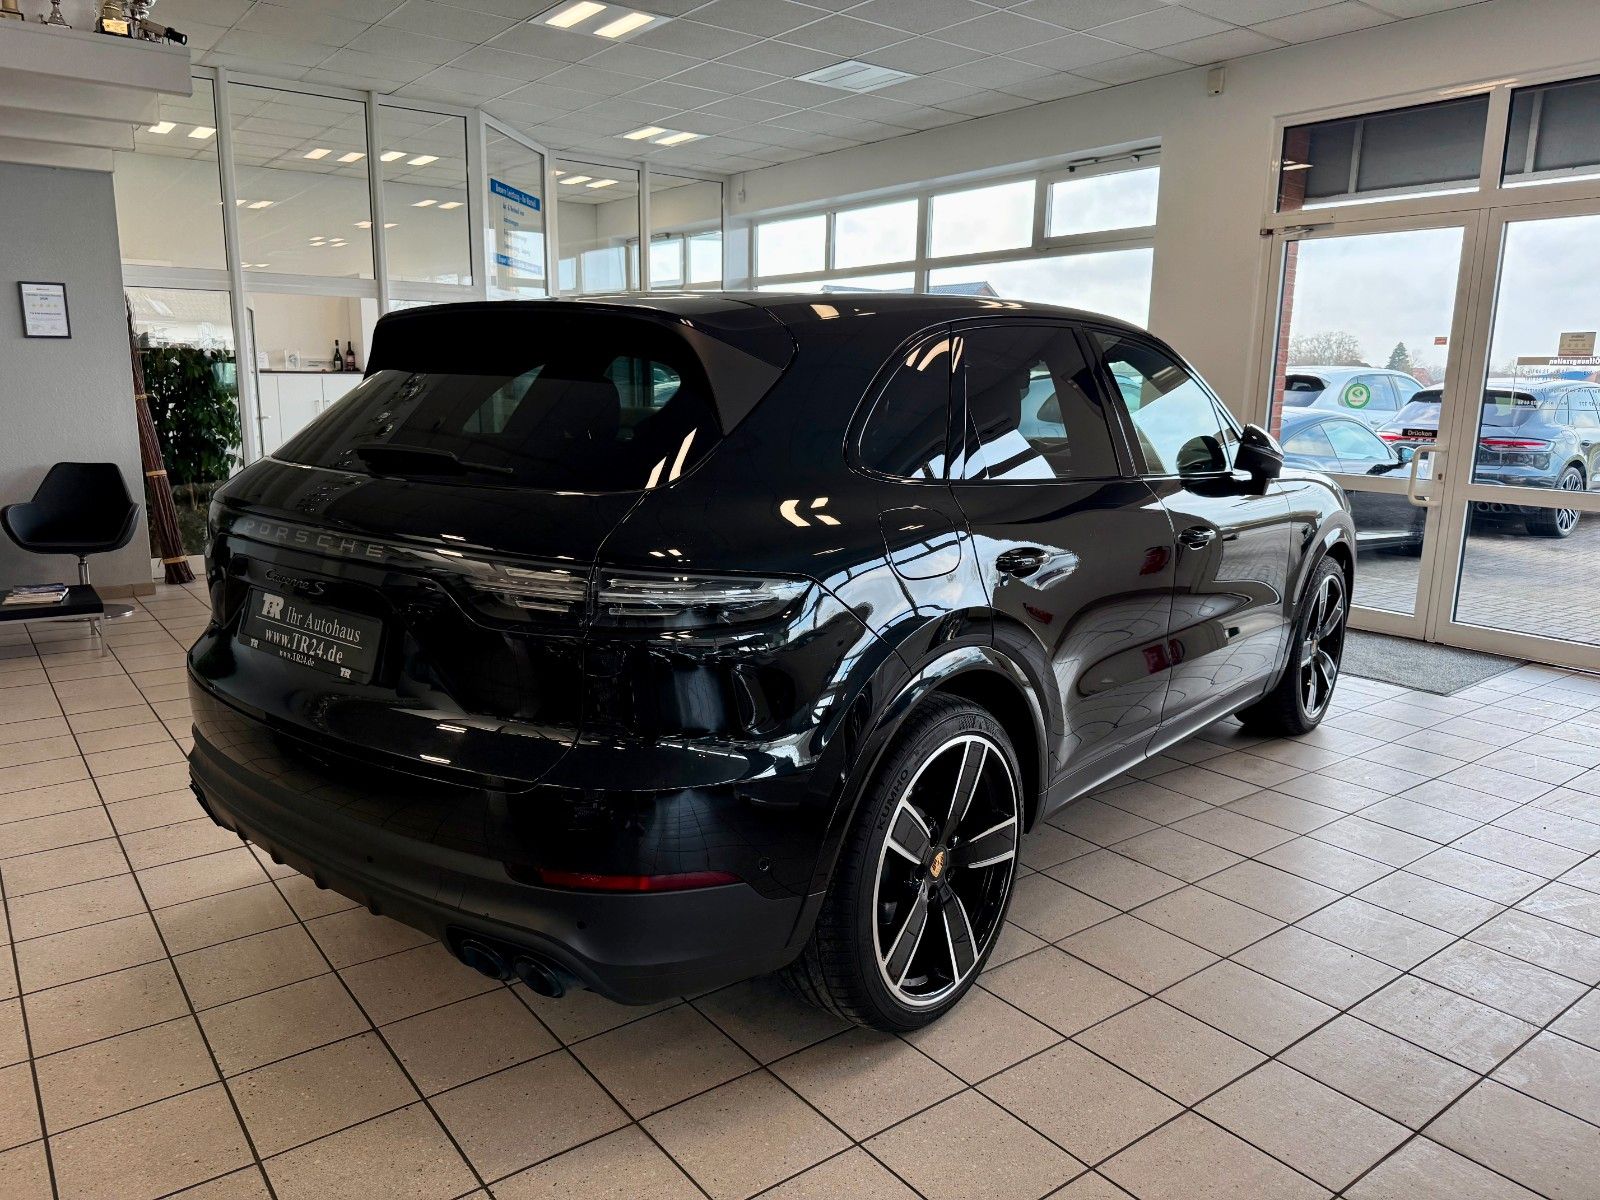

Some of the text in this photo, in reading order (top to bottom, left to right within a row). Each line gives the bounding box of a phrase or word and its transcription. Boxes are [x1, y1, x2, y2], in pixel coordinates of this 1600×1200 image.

[1407, 429, 1432, 437] Drücken
[245, 520, 384, 558] PORSCHE
[265, 568, 327, 596] Cayenne S
[286, 606, 303, 626] Ihr
[304, 612, 361, 643] Autohaus
[265, 629, 343, 664] www.TR24.de
[876, 768, 909, 830] KUMHO
